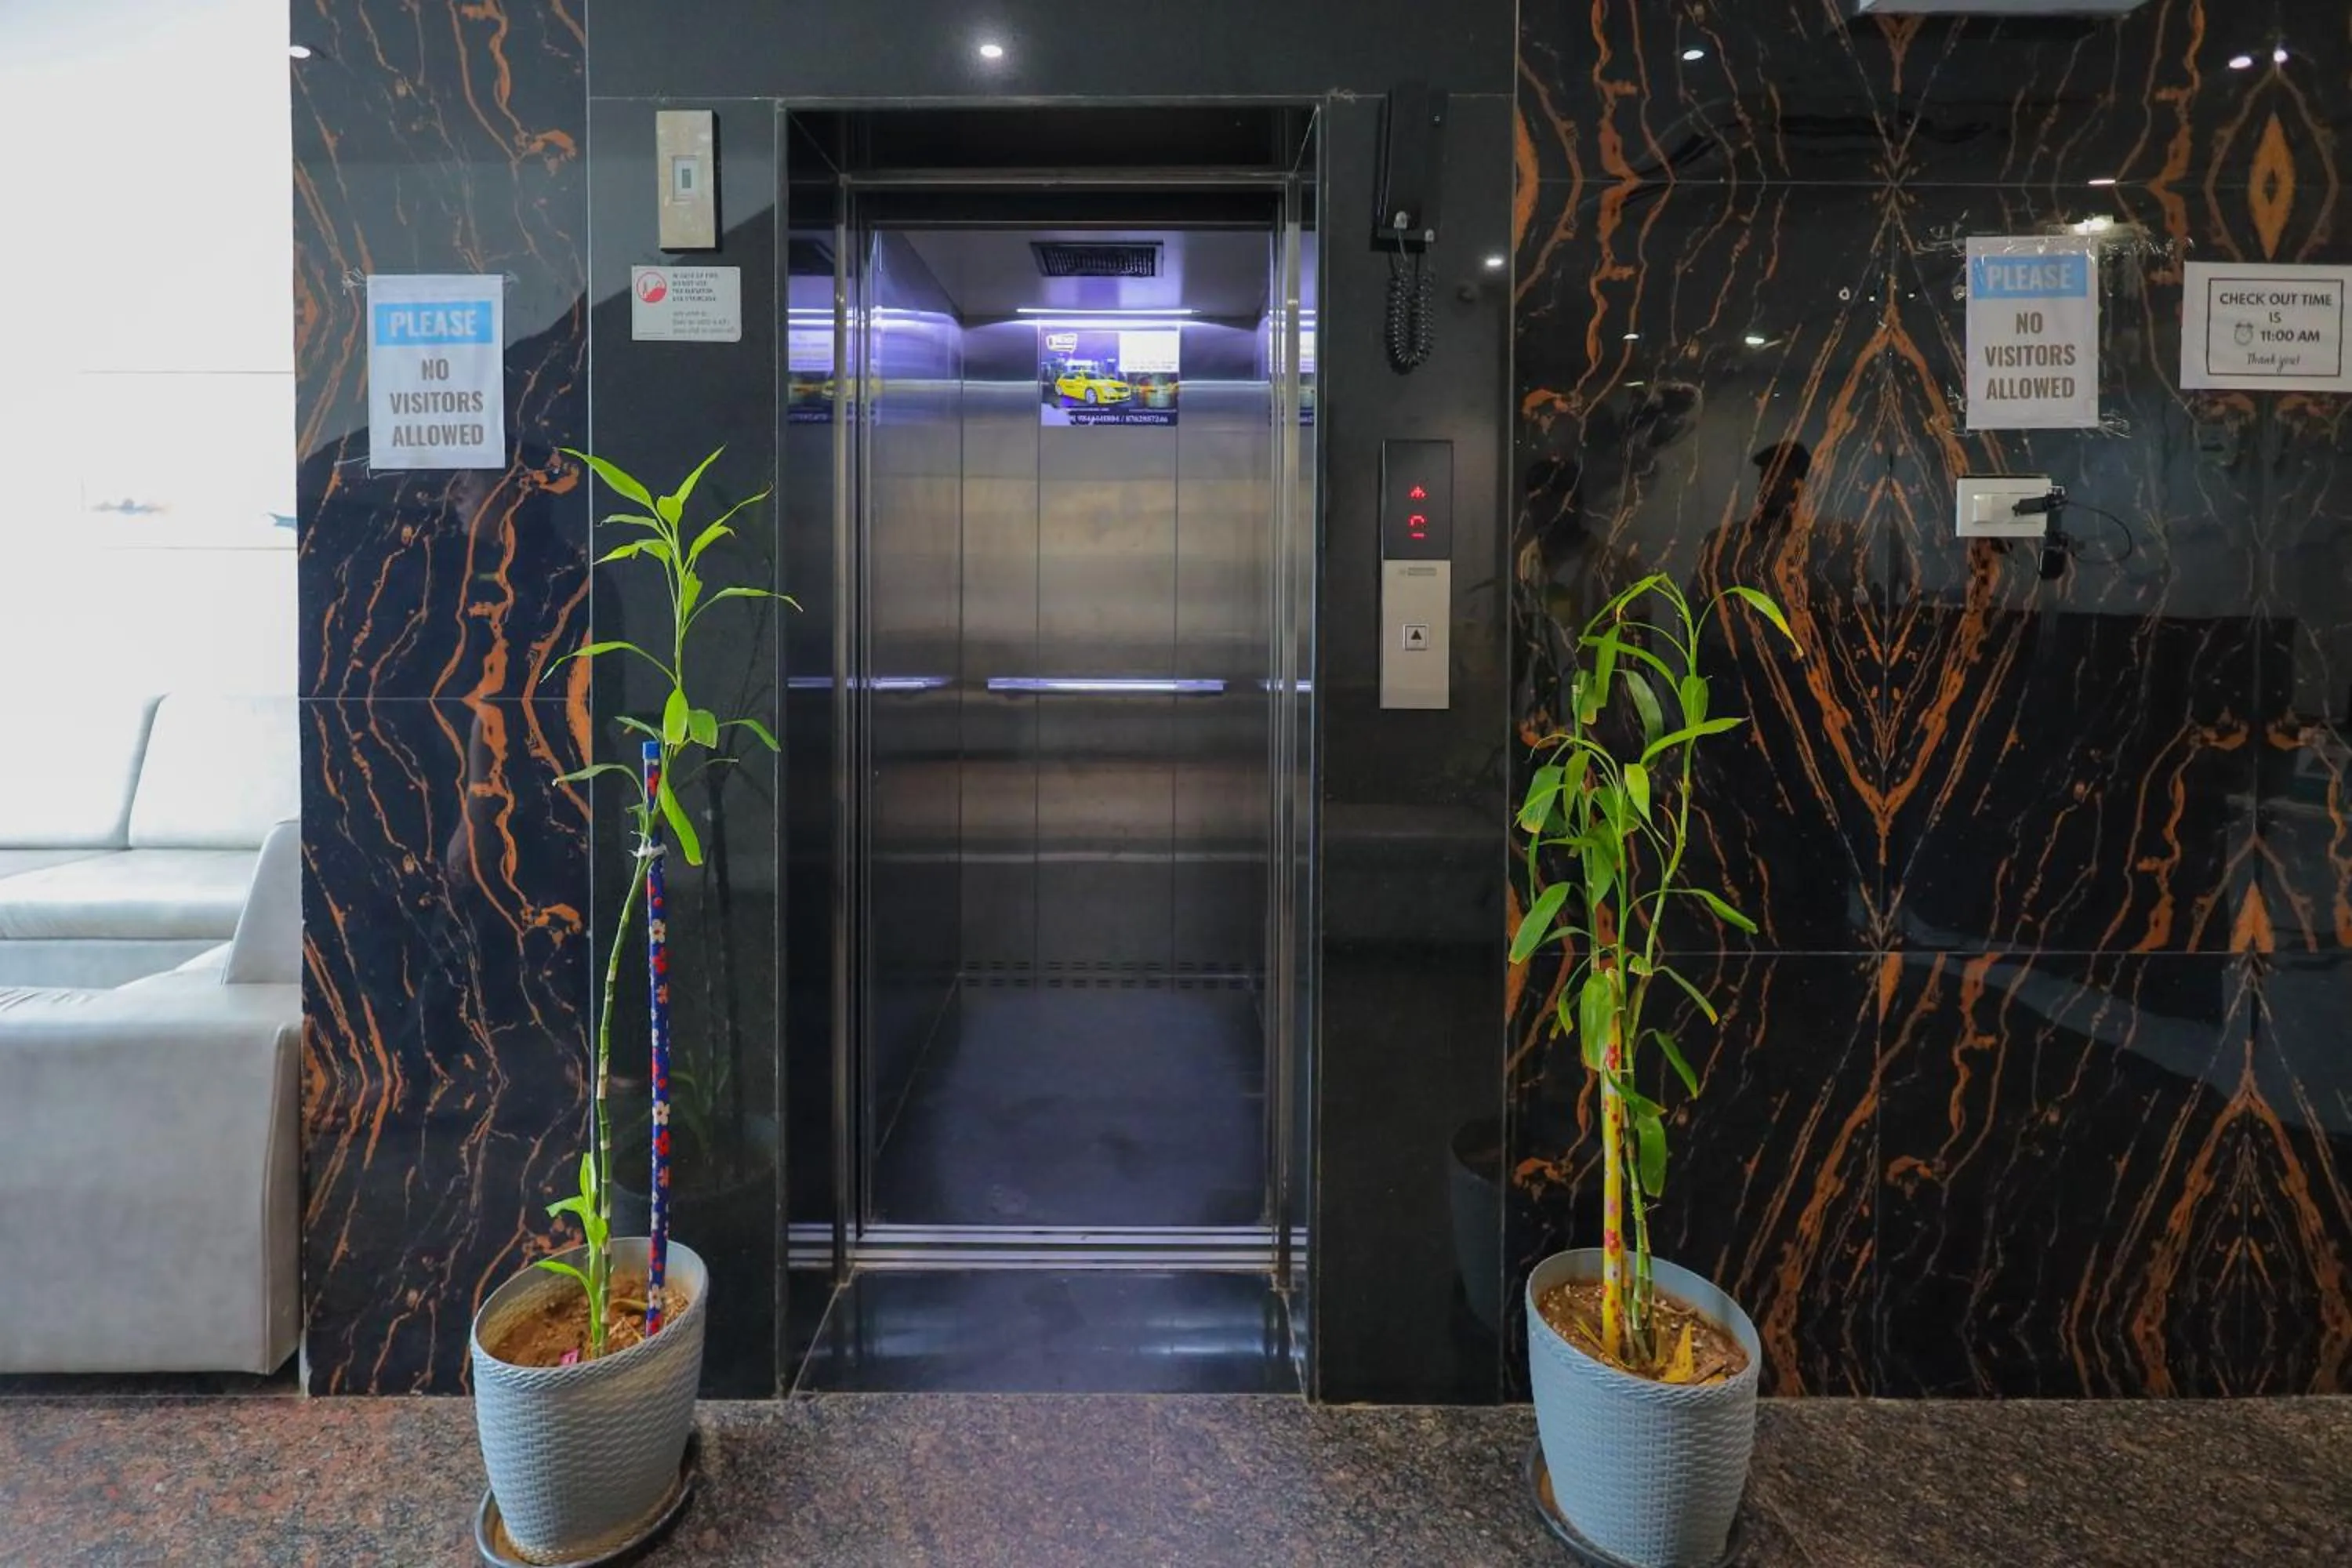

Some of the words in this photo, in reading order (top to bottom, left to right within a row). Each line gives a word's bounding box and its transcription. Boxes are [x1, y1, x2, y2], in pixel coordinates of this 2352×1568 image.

[1987, 263, 2071, 291] PLEASE
[2220, 292, 2266, 306] CHECK
[2269, 292, 2298, 306] OUT
[2301, 293, 2332, 307] TIME
[391, 310, 477, 337] PLEASE
[2016, 312, 2044, 334] NO
[2269, 311, 2282, 324] IS
[2259, 330, 2294, 342] 11:00
[2297, 330, 2320, 343] AM
[1985, 344, 2076, 368] VISITORS
[2247, 352, 2274, 365] Thank
[421, 358, 449, 381] NO
[1986, 377, 2075, 400] ALLOWED
[390, 390, 484, 415] VISITORS
[393, 423, 484, 447] ALLOWED
